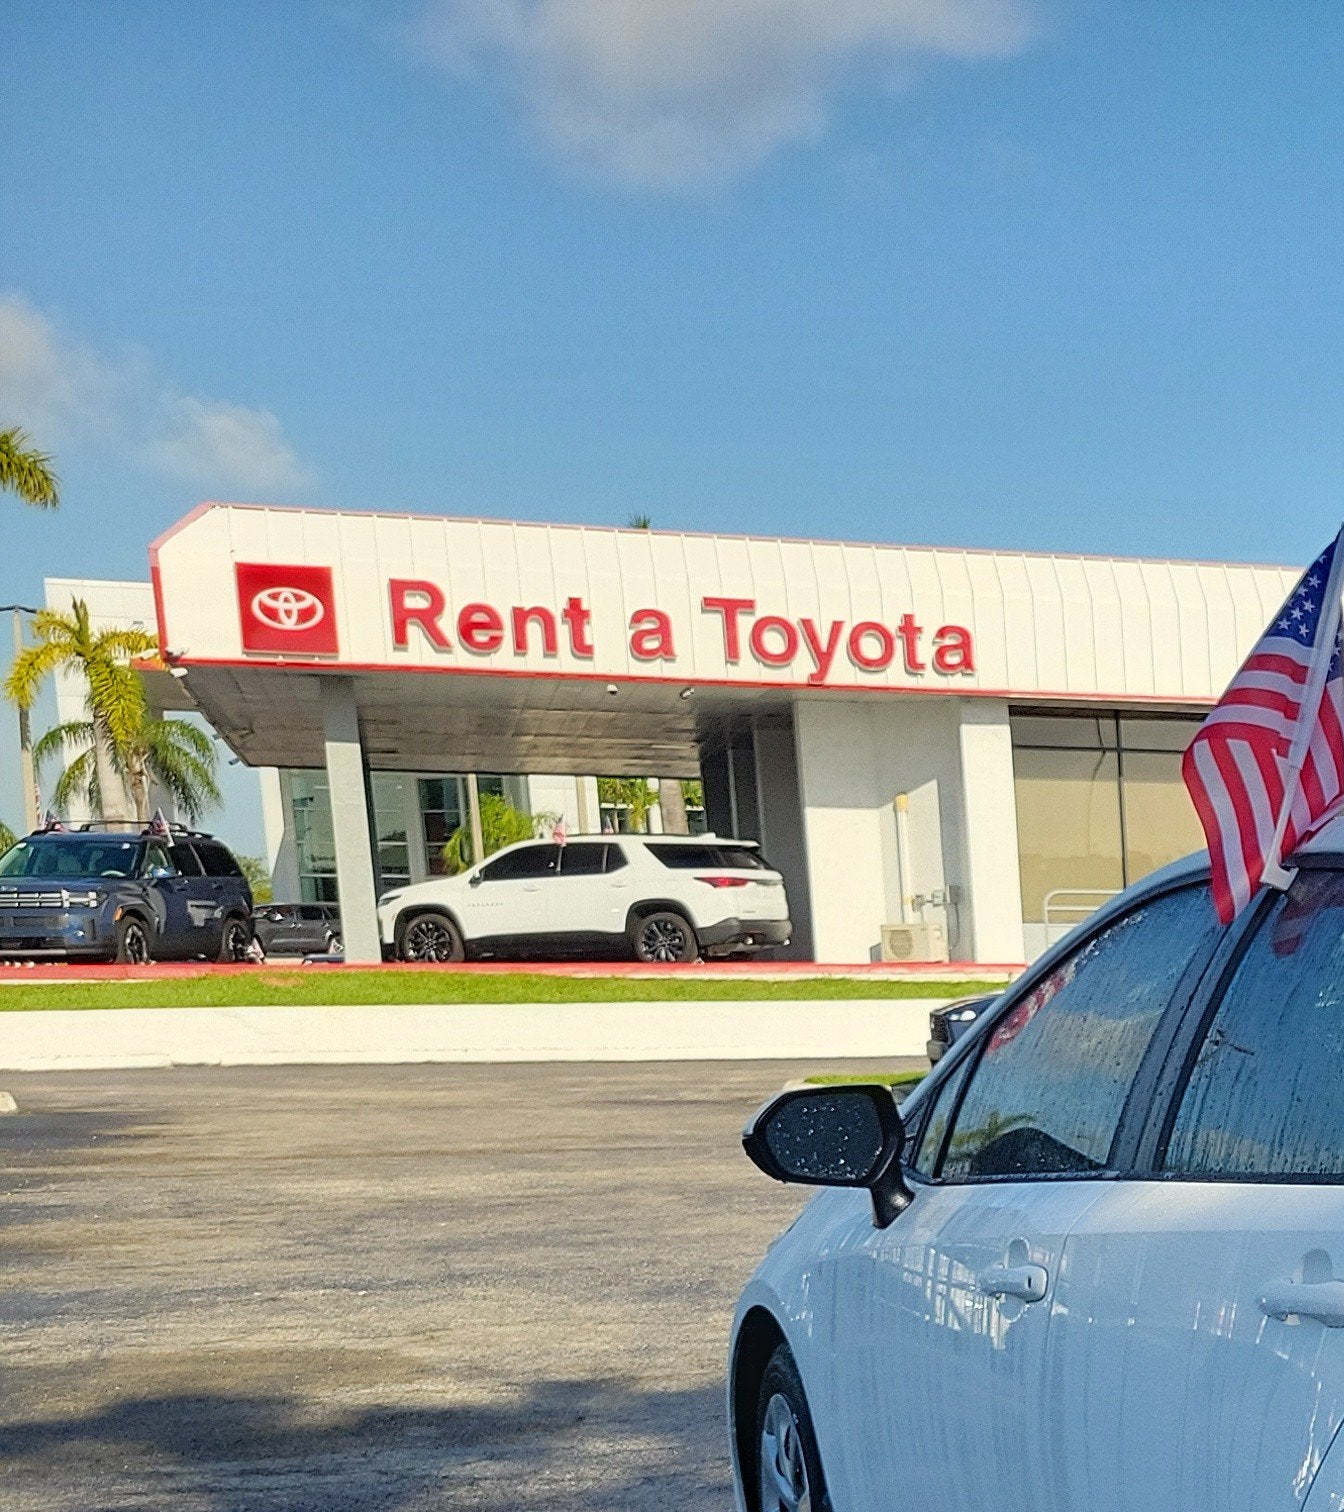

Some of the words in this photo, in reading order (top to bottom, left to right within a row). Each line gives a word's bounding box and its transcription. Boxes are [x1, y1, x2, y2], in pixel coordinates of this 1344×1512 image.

[389, 577, 594, 659] Rent
[628, 607, 677, 662] a
[702, 596, 976, 686] Toyota
